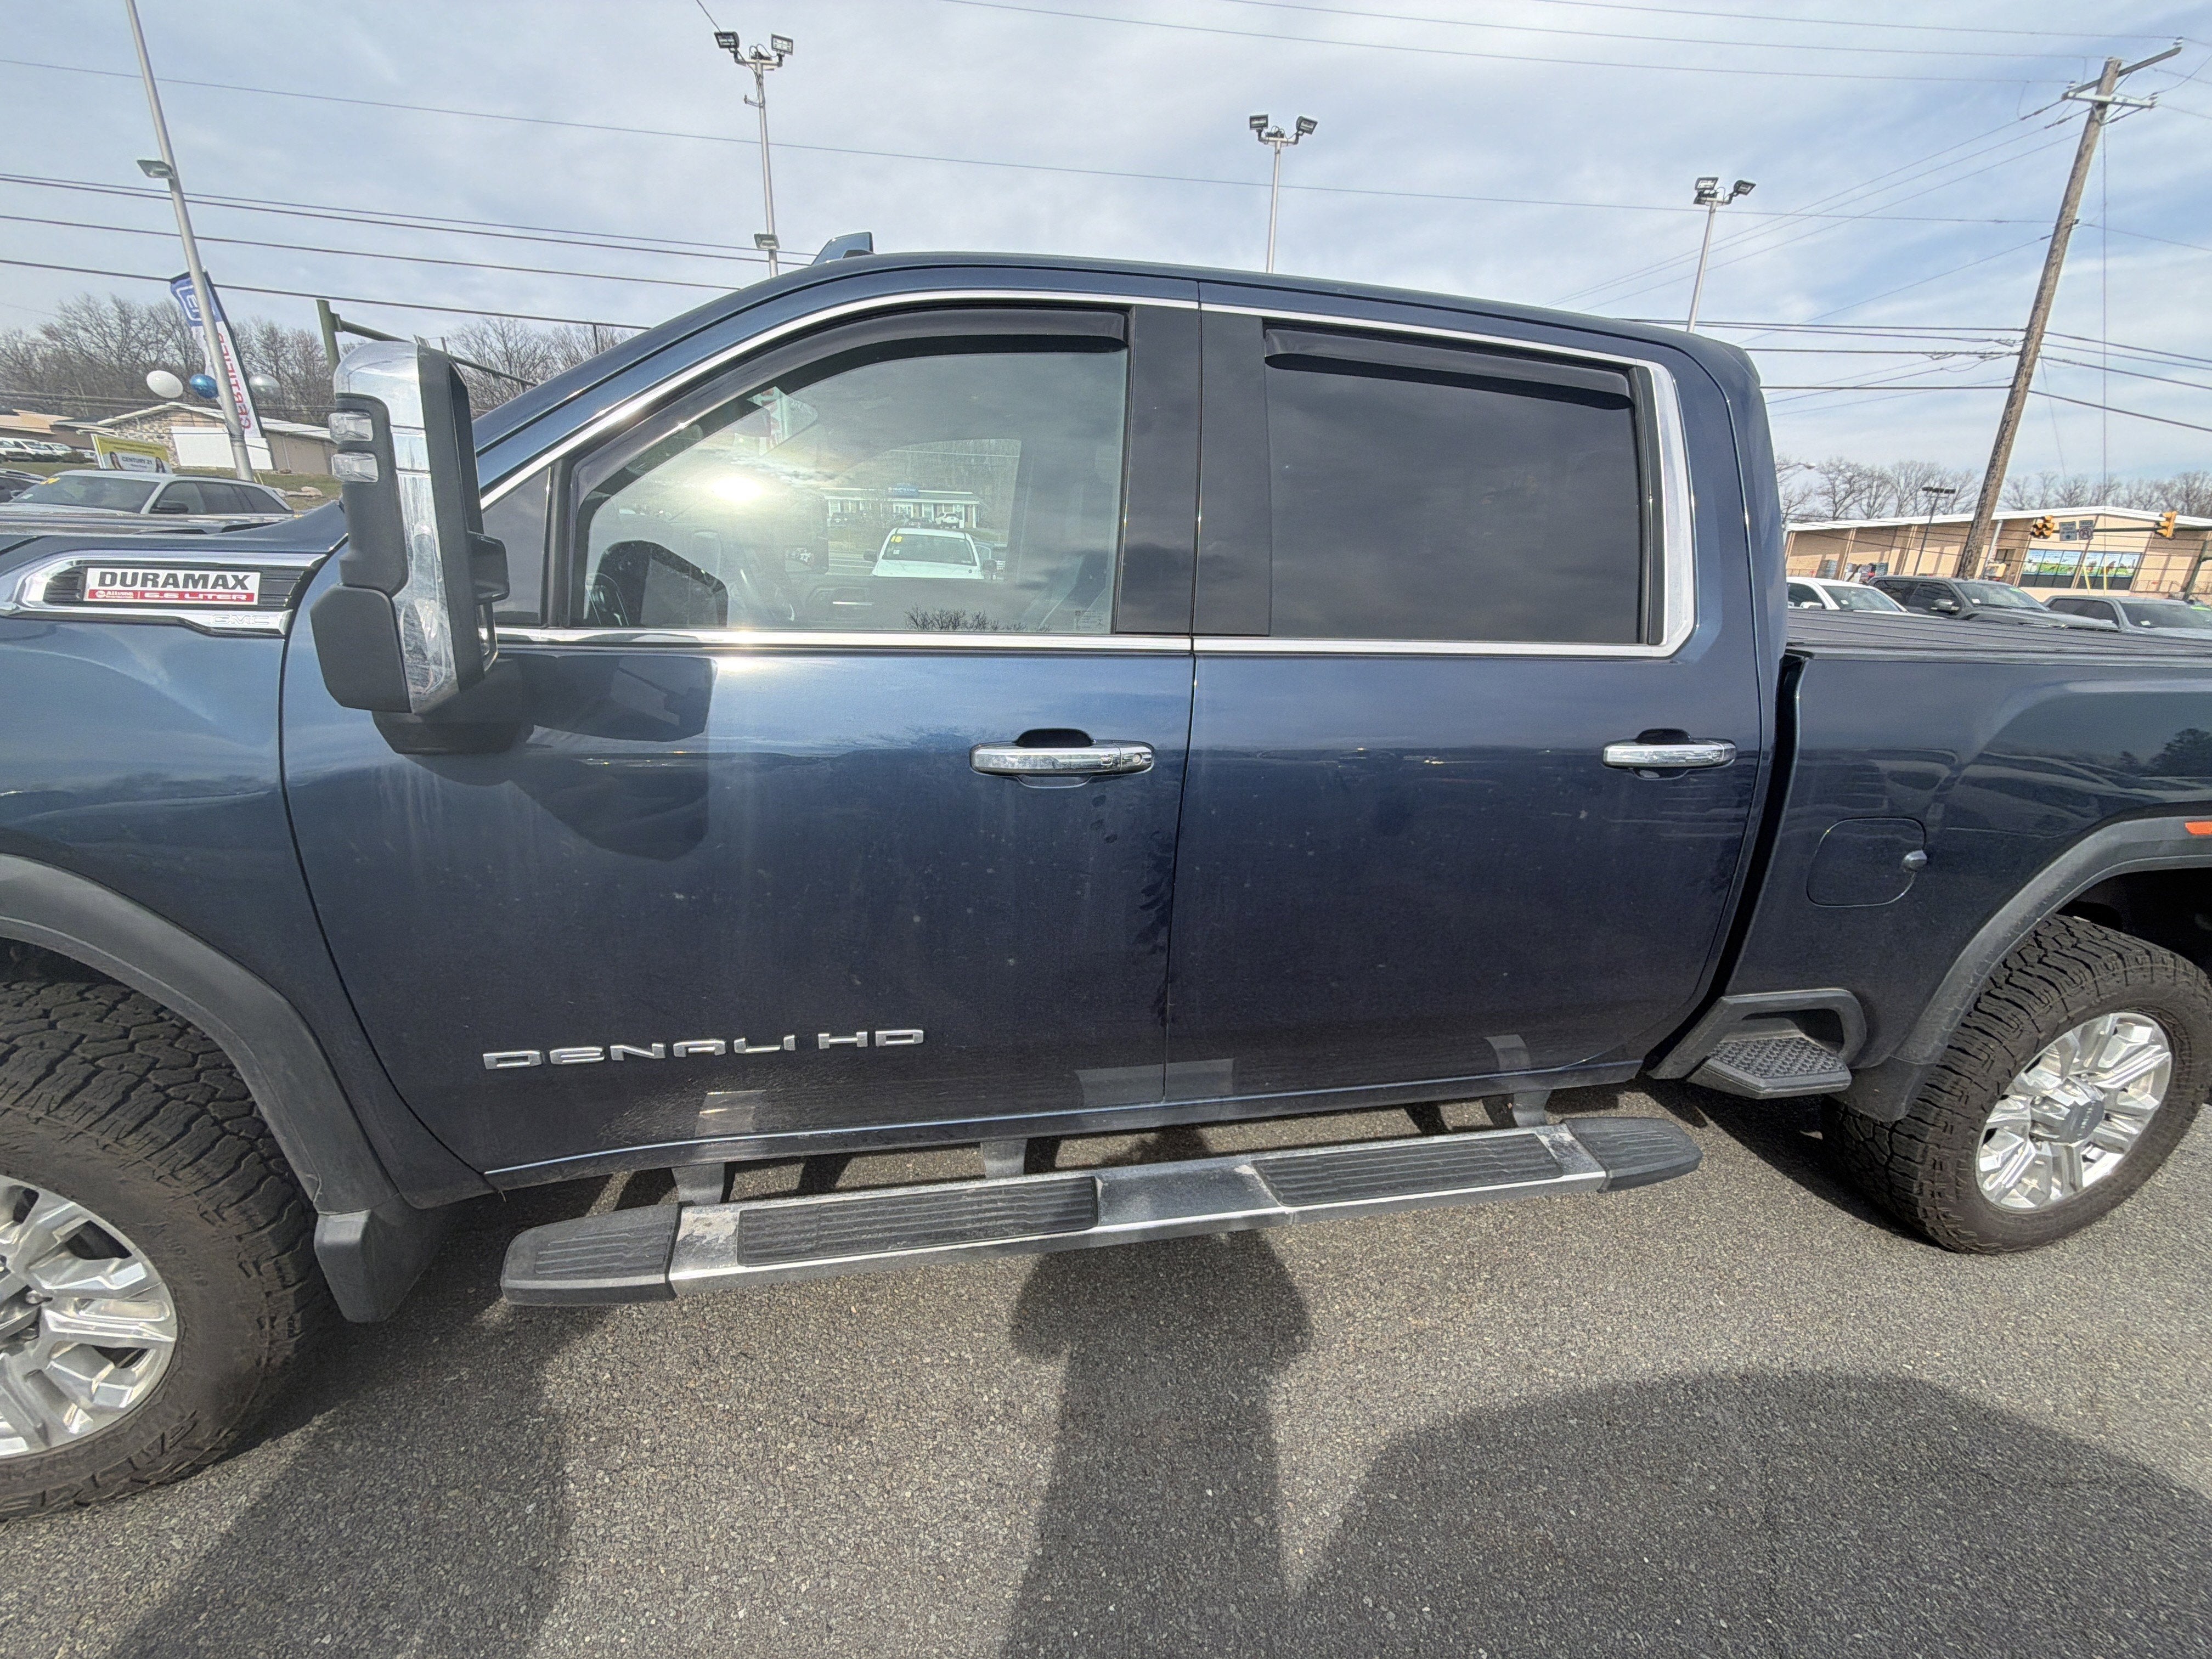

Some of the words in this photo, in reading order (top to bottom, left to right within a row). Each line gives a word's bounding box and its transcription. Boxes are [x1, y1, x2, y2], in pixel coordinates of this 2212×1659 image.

[121, 456, 145, 464] CENTURY
[98, 571, 251, 590] DURAMAX
[211, 613, 270, 625] GMC
[483, 1034, 796, 1070] DENALI
[817, 1029, 924, 1049] HD
